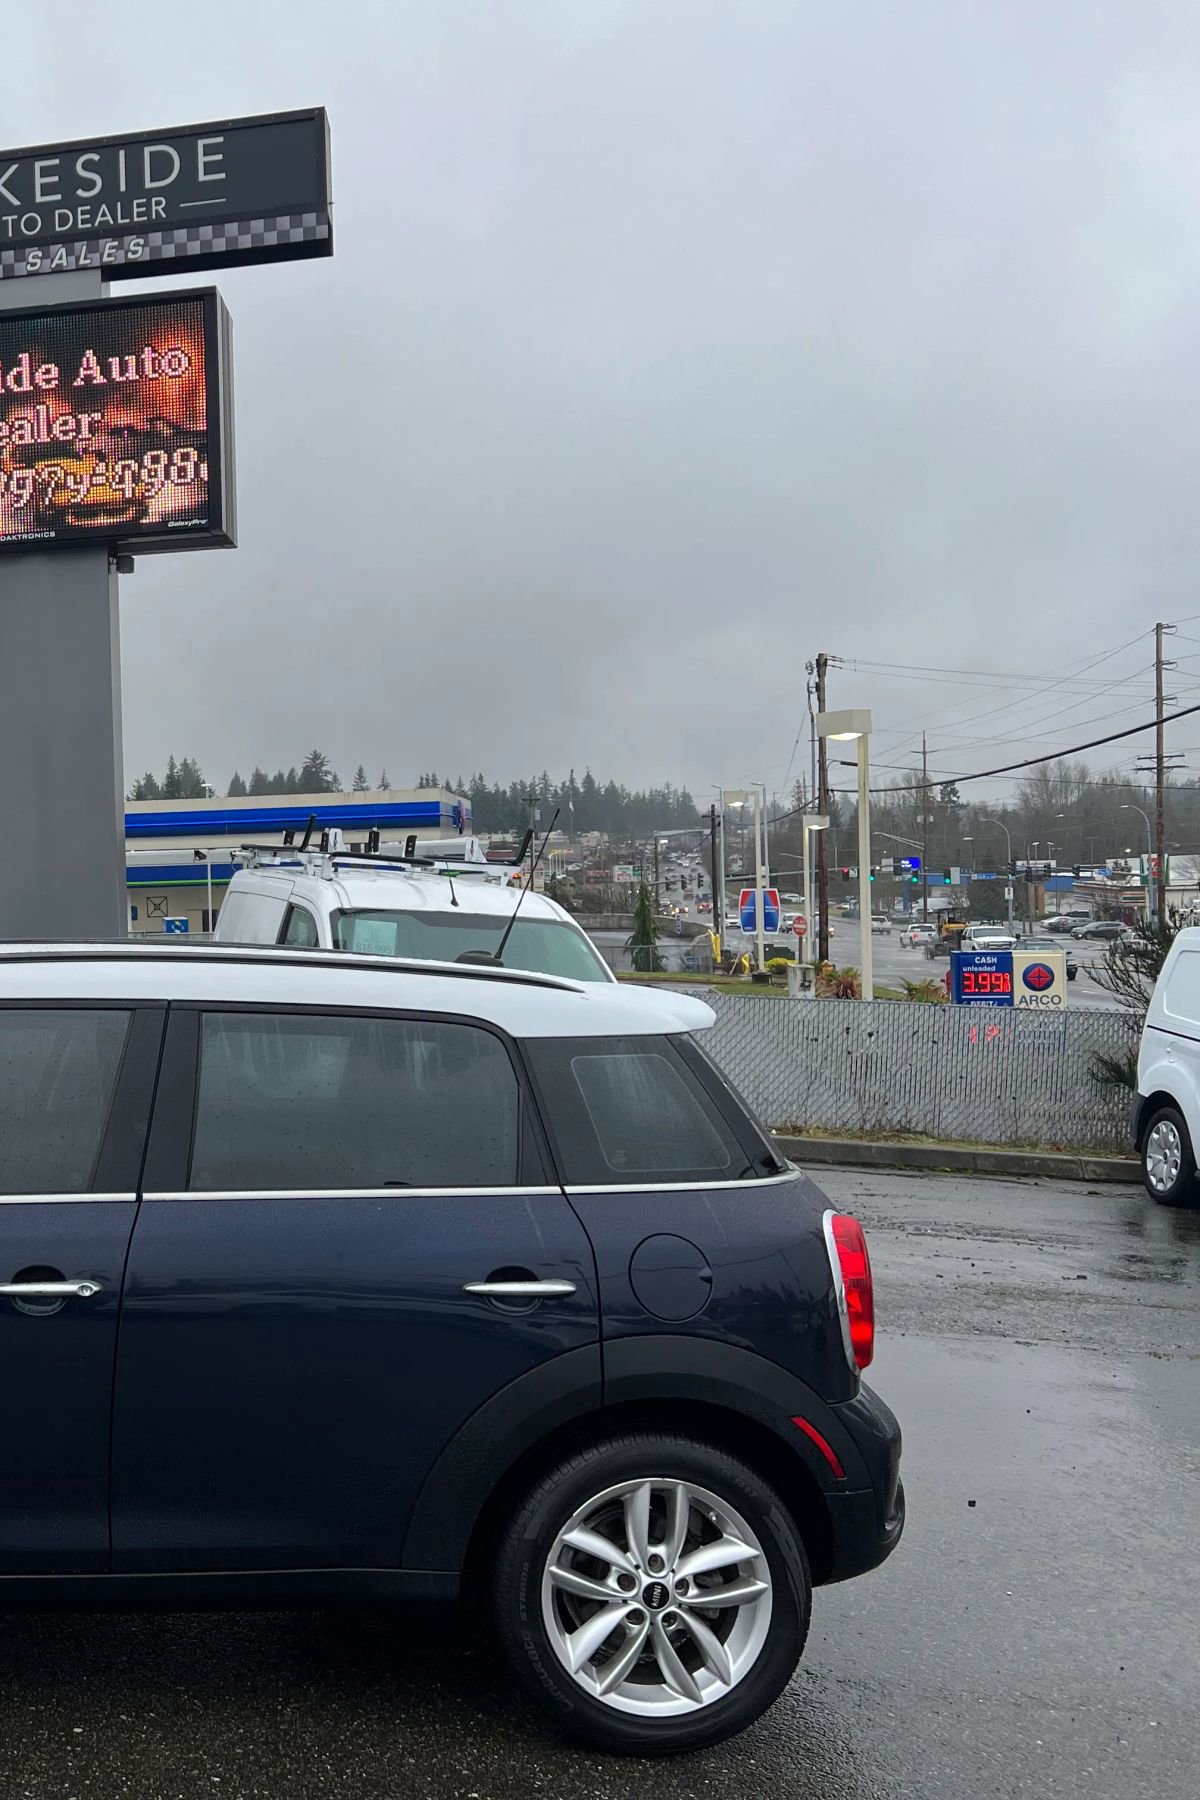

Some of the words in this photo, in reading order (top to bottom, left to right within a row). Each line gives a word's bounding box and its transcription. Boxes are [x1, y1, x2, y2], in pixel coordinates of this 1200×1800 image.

[54, 196, 167, 232] DEALER
[26, 237, 145, 272] SALES
[73, 344, 191, 388] Auto
[0, 530, 57, 542] DAKTRONICS
[974, 956, 998, 964] CASH
[1018, 994, 1062, 1006] ARCO
[650, 1584, 662, 1607] MINI
